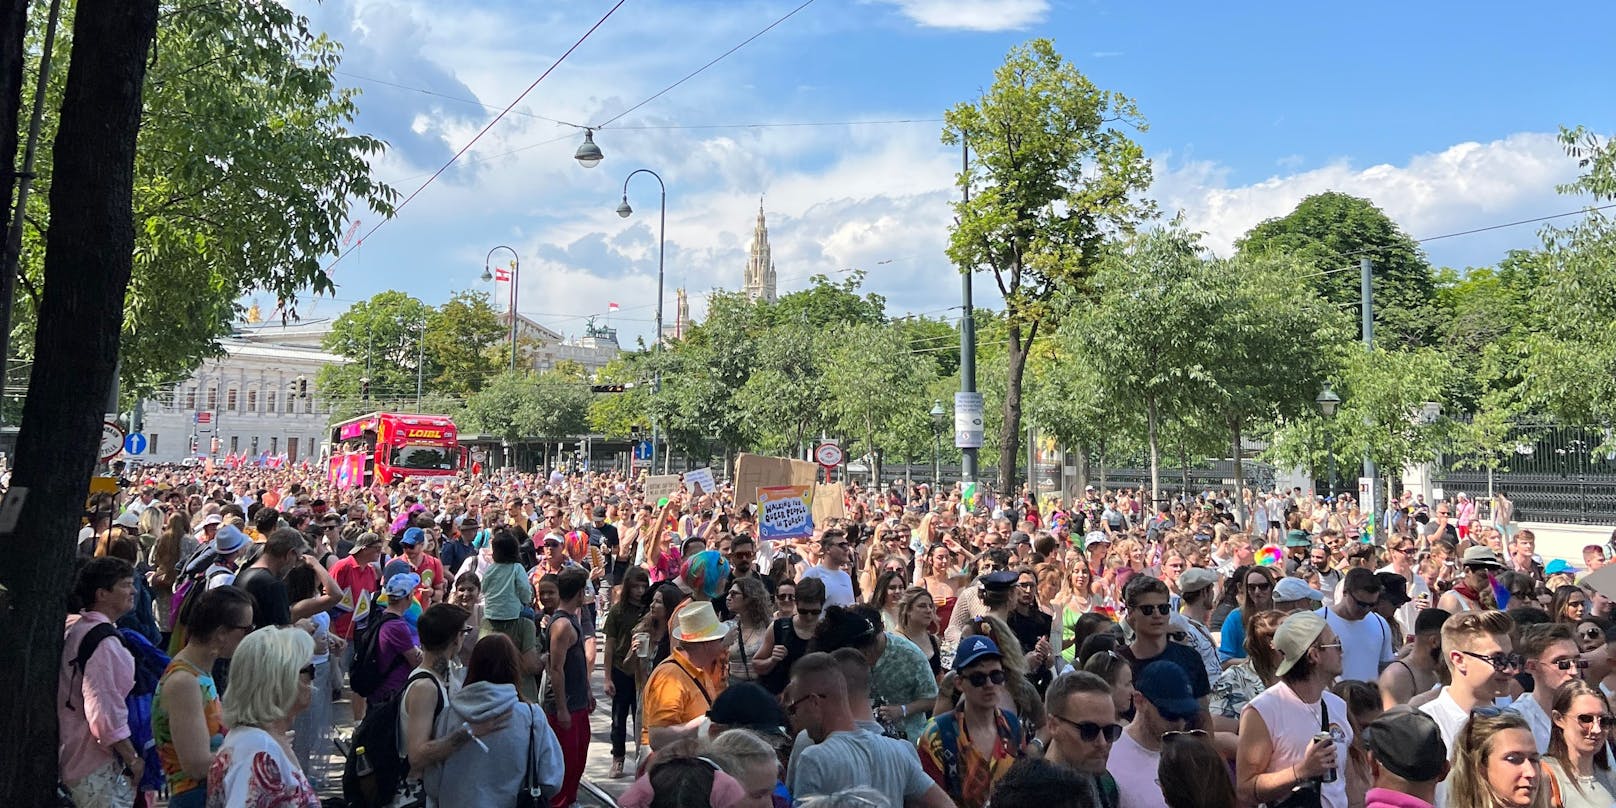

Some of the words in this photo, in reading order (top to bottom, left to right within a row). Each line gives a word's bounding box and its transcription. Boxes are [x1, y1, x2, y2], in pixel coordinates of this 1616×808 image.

[766, 501, 791, 513] WALKING
[766, 512, 786, 522] QUEER
[786, 507, 806, 518] PEOPLE
[783, 515, 804, 527] TURKEY
